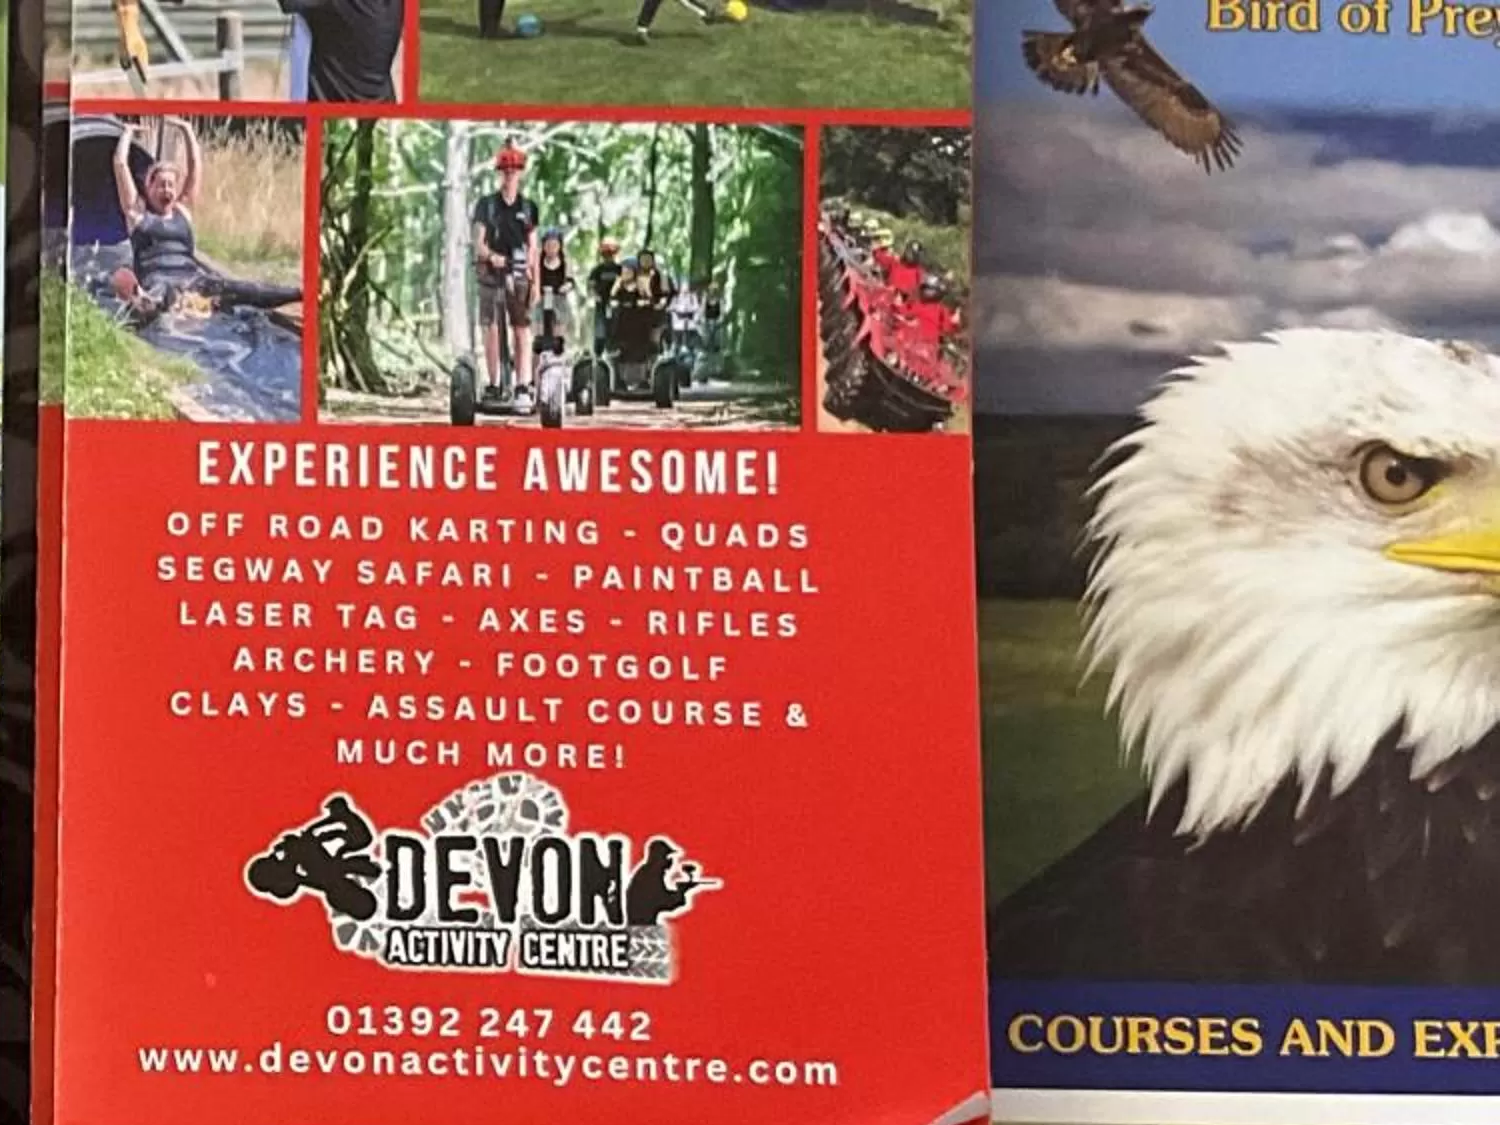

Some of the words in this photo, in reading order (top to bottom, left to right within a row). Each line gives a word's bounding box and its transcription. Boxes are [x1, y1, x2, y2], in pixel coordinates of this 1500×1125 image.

[1206, 0, 1320, 32] Bird
[1339, 0, 1391, 34] of
[200, 441, 498, 489] EXPERIENCE
[524, 447, 780, 495] AWESOME!
[167, 512, 246, 538] OFF
[270, 514, 386, 540] ROAD
[410, 518, 601, 544] KARTING
[661, 522, 810, 549] QUADS
[157, 557, 334, 585] SEGWAY
[357, 560, 512, 588] SAFARI
[574, 566, 819, 594] PAINTBALL
[180, 602, 314, 629] LASER
[337, 604, 419, 630] TAG
[479, 607, 587, 634] AXES
[648, 610, 798, 638] RIFLES
[233, 647, 437, 675] ARCHERY
[498, 652, 728, 681] FOOTGOLF
[171, 691, 307, 718] CLAYS
[367, 695, 563, 723] ASSAULT
[587, 699, 763, 727] COURSE
[786, 703, 809, 728] &
[337, 739, 462, 766] MUCH
[487, 741, 627, 769] MORE!
[385, 835, 624, 925] DEVON
[388, 929, 510, 966] ACTIVITY
[523, 932, 629, 967] CENTRE
[327, 1005, 462, 1037] 01392
[480, 1008, 553, 1039] 247
[572, 1011, 652, 1041] 442
[1008, 1013, 1263, 1057] COURSES
[1280, 1018, 1396, 1058] AND
[139, 1043, 839, 1085] www.devonactivitycentre.com
